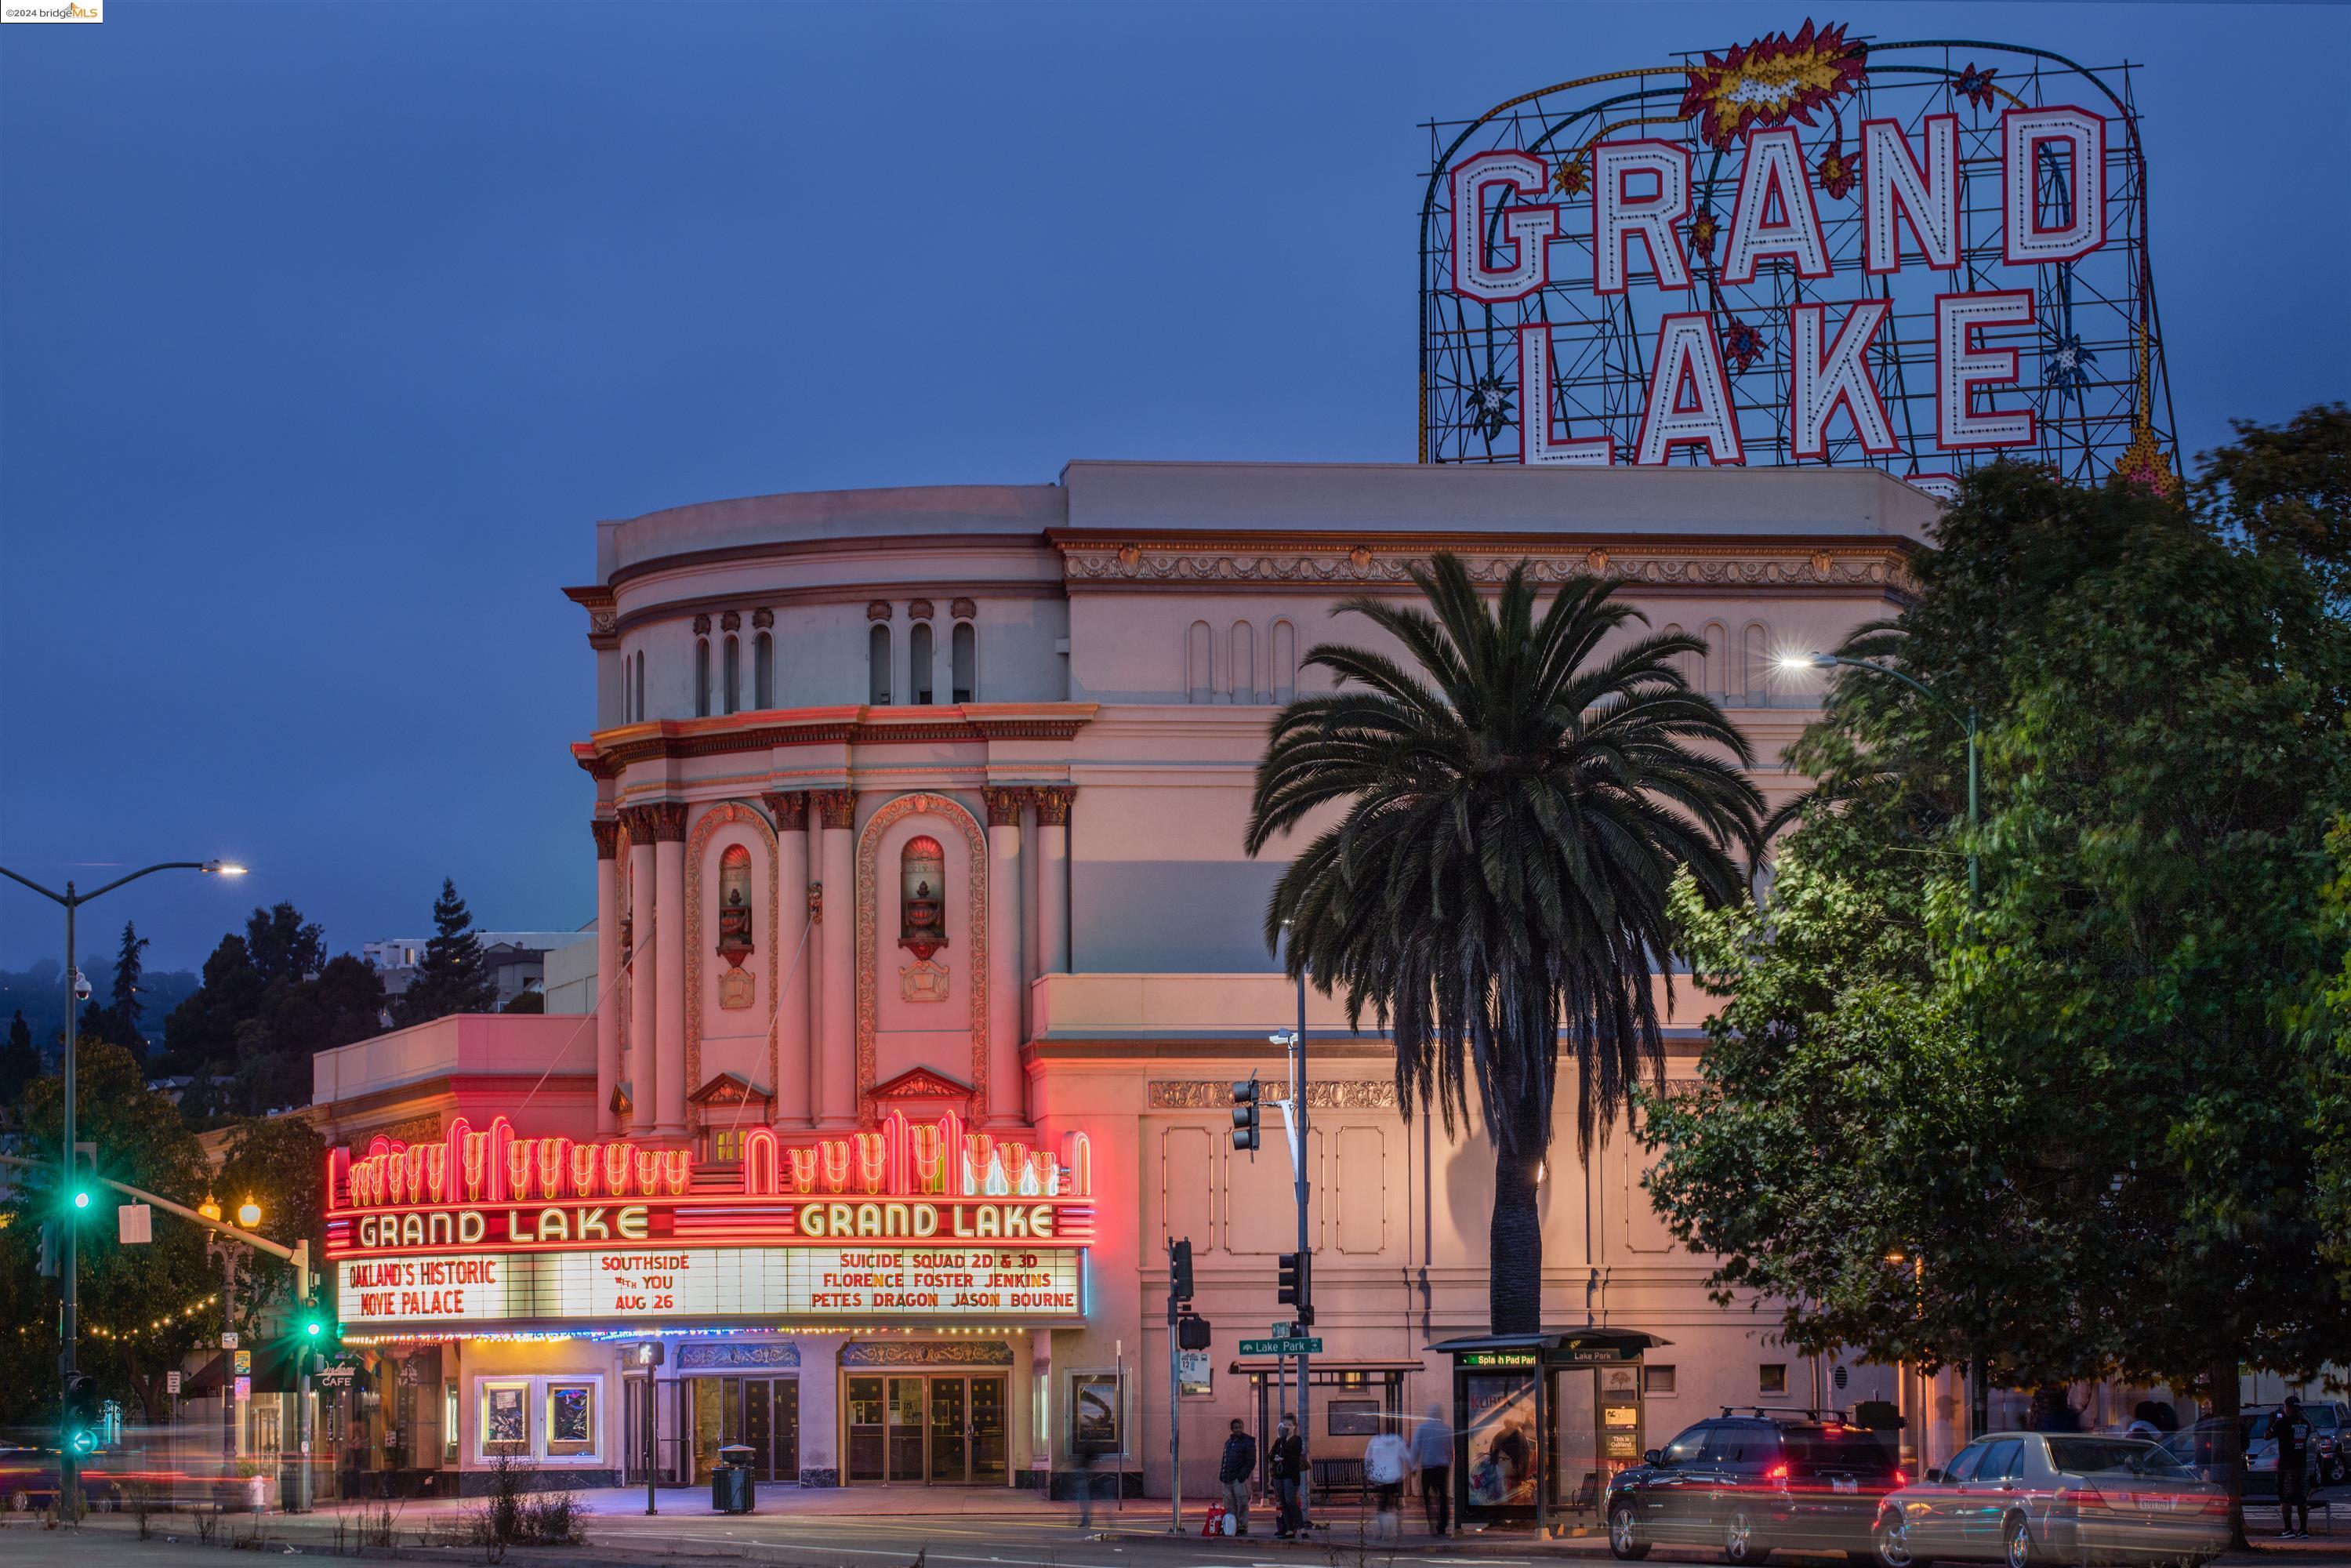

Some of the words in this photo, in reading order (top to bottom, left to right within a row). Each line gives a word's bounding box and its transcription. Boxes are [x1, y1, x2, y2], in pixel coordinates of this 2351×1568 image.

[1450, 104, 2106, 303] GRAND
[1518, 289, 2037, 466] LAKE
[360, 1210, 484, 1247] GRAND
[509, 1205, 648, 1243] LAKE
[800, 1203, 938, 1238] GRAND
[953, 1203, 1053, 1238] LAKE
[601, 1254, 690, 1271] SOUTHSIDE
[840, 1253, 902, 1268] SUICIDE
[912, 1254, 965, 1269] SQUAD
[971, 1253, 993, 1269] 2D
[1000, 1254, 1011, 1269] &
[1018, 1254, 1038, 1269] 3D
[350, 1262, 415, 1289] OAKLAND'S
[420, 1260, 497, 1286] HISTORIC
[615, 1276, 637, 1289] WITH
[641, 1275, 673, 1290] YOU
[823, 1272, 904, 1287] FLORENCE
[913, 1272, 974, 1287] FOSTER
[984, 1272, 1051, 1288] JENKINS
[361, 1291, 396, 1317] MOVIE
[401, 1289, 465, 1315] PALACE
[615, 1295, 647, 1310] AUG
[653, 1294, 673, 1308] 26
[811, 1292, 862, 1308] PETES
[873, 1292, 939, 1307] DRAGON
[950, 1292, 1000, 1307] JASON
[1010, 1292, 1074, 1307] BOURNE
[1256, 1341, 1279, 1352] Lake
[1283, 1341, 1304, 1352] Park
[1478, 1356, 1504, 1366] Splah
[1505, 1356, 1519, 1365] Pad
[1574, 1352, 1592, 1360] Lake
[1594, 1352, 1611, 1360] Park
[322, 1377, 352, 1386] CAFE
